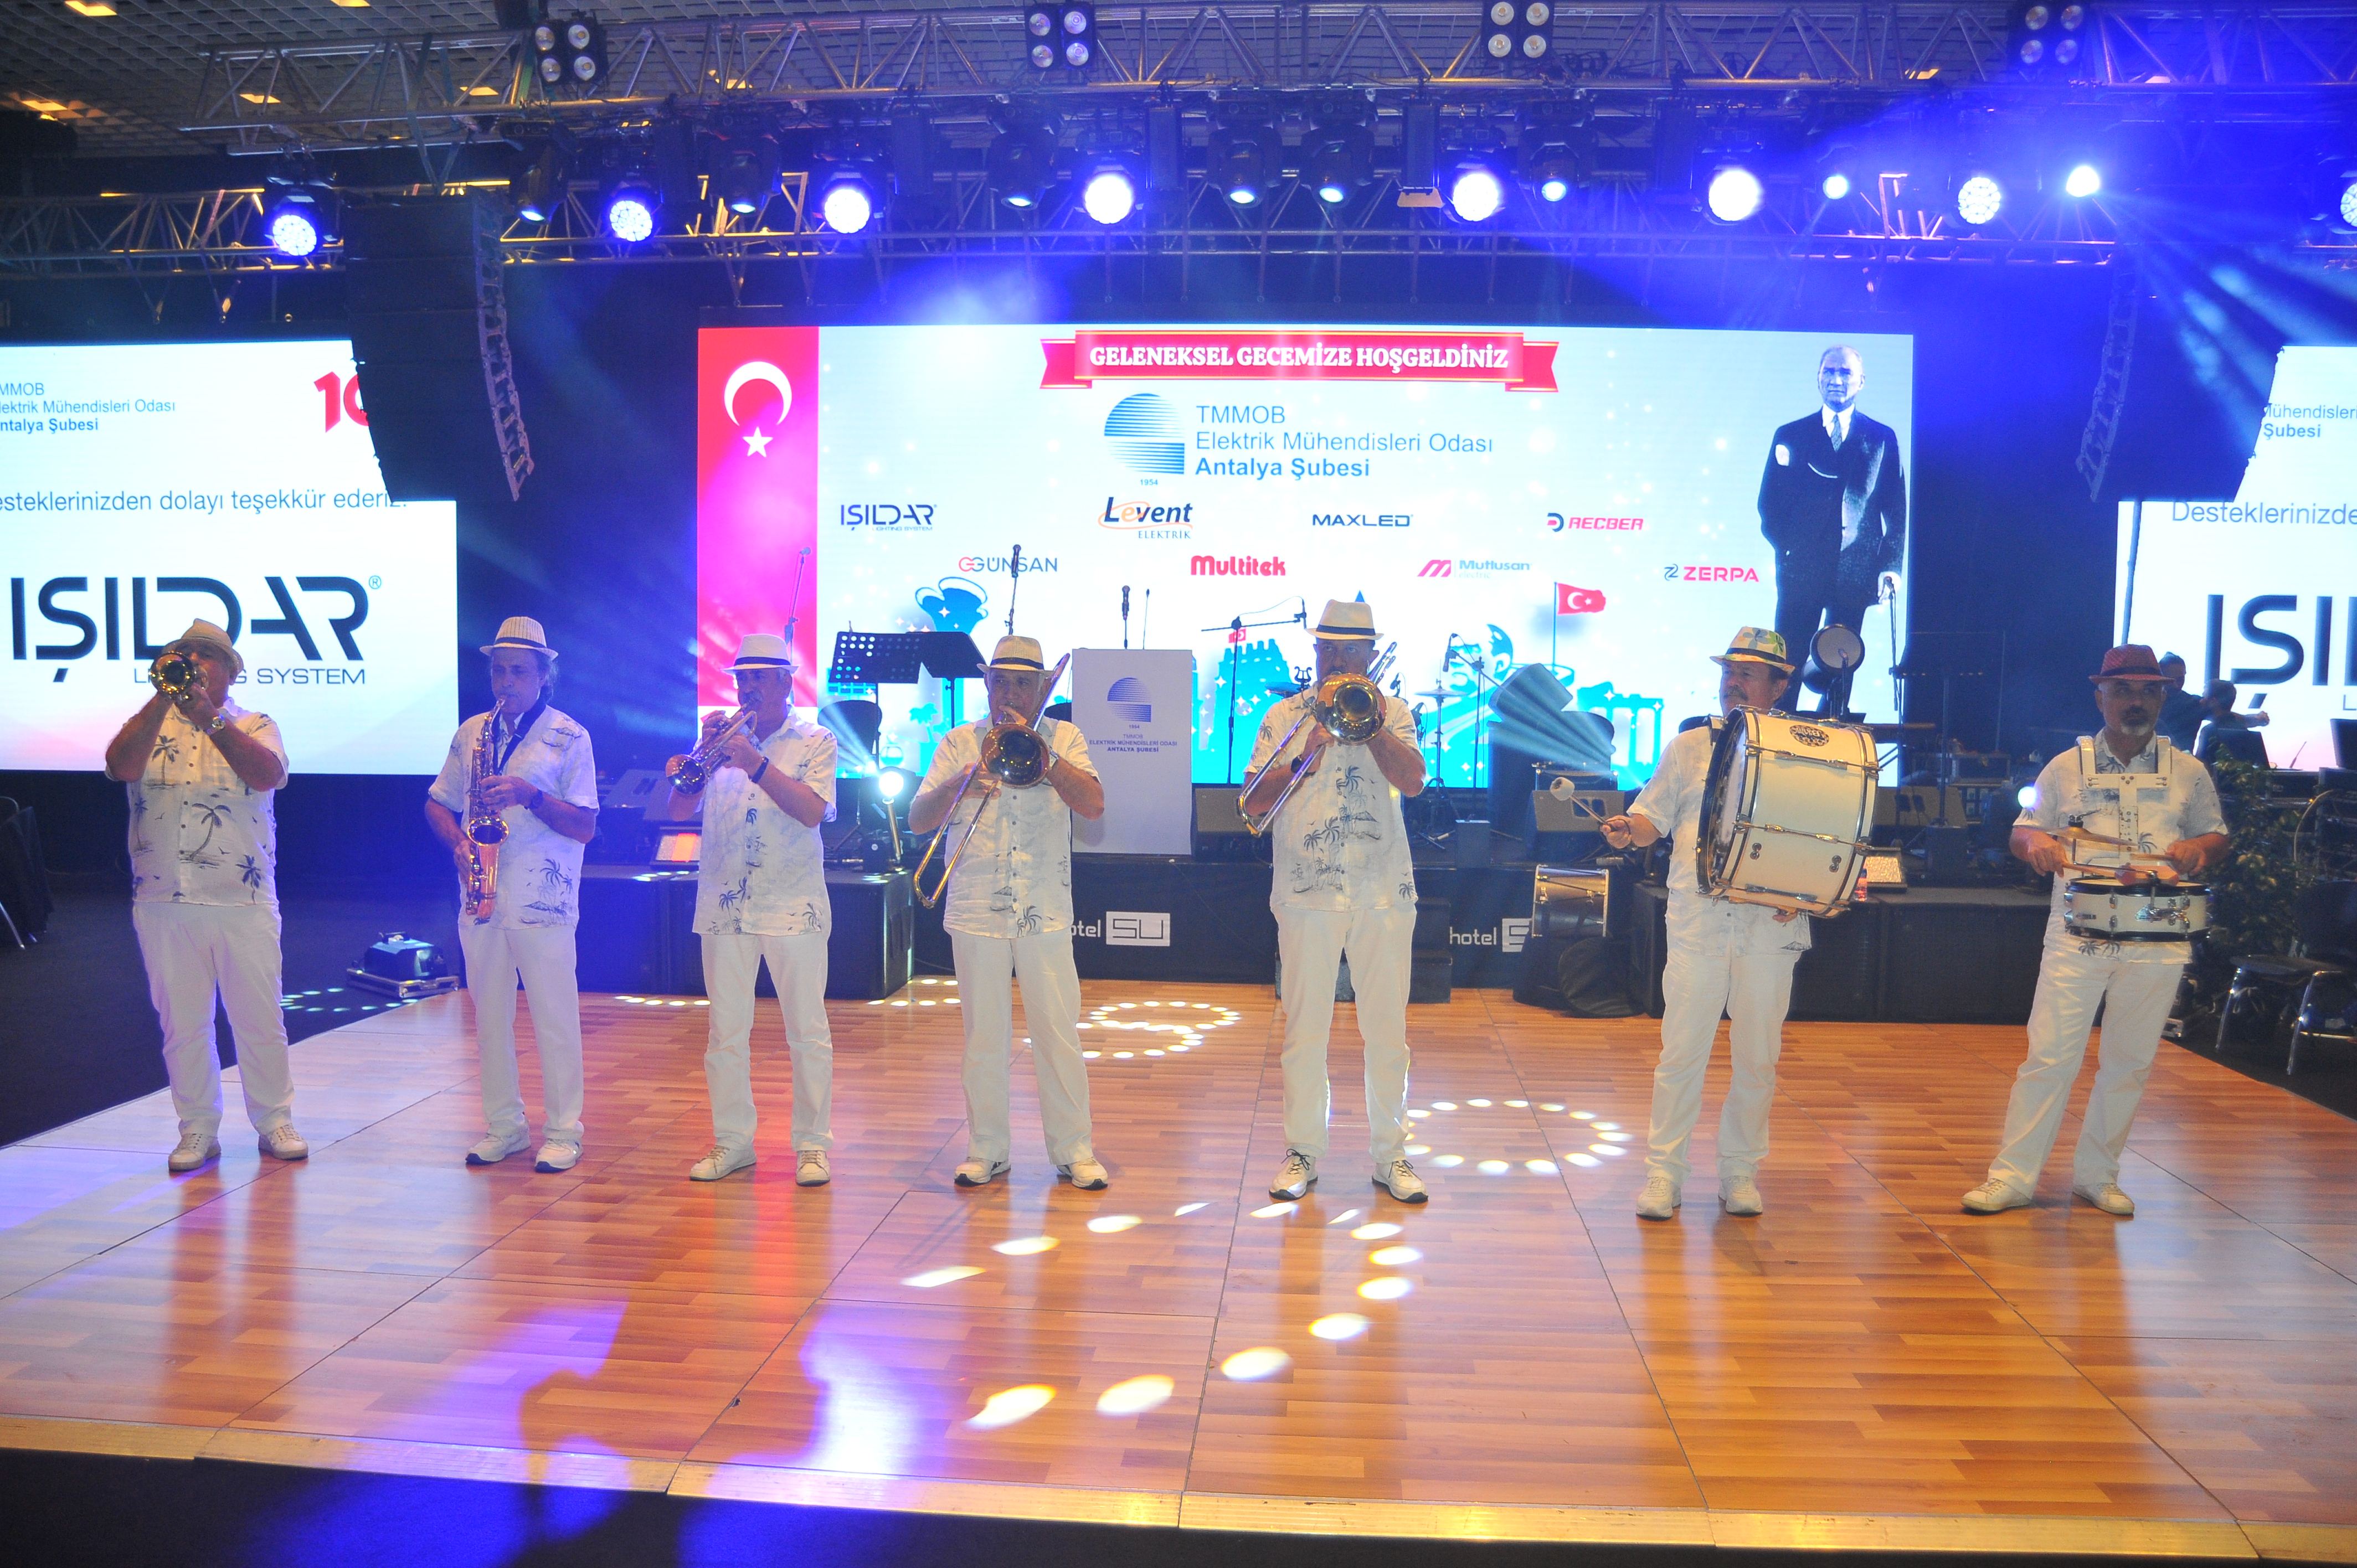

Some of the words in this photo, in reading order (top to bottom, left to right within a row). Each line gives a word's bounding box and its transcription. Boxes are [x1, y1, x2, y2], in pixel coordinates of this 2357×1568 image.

[1089, 347, 1234, 367] GELENEKSEL
[1236, 342, 1352, 367] GECEMİZE
[1356, 344, 1509, 374] HOŞGELDİNİZ
[43, 400, 130, 413] Mühendisleri
[135, 399, 175, 412] Odası
[1196, 405, 1285, 424] TMMOB
[49, 418, 98, 434] Şubesi
[2263, 423, 2321, 440] Şubesi
[1196, 431, 1275, 450] Elektrik
[1283, 432, 1421, 451] Mühendisleri
[1429, 432, 1493, 452] Odası
[1195, 457, 1283, 481] Antalya
[1290, 457, 1370, 481] Şubesi
[0, 491, 151, 511] steklerinizden
[159, 490, 223, 515] dolayı
[231, 489, 326, 514] teşekkür
[1104, 497, 1193, 523] Levent
[841, 504, 934, 531] IŞILDAR
[1313, 514, 1410, 527] MAXLED
[1138, 530, 1191, 539] ELEKTRİK
[1191, 555, 1285, 576] Multitek
[1459, 560, 1530, 570] Mutlusan
[1684, 566, 1759, 582] ZERPA
[11, 576, 368, 683] IŞILDAR
[257, 668, 365, 684] SYSTEM
[1449, 926, 1496, 945] hotel
